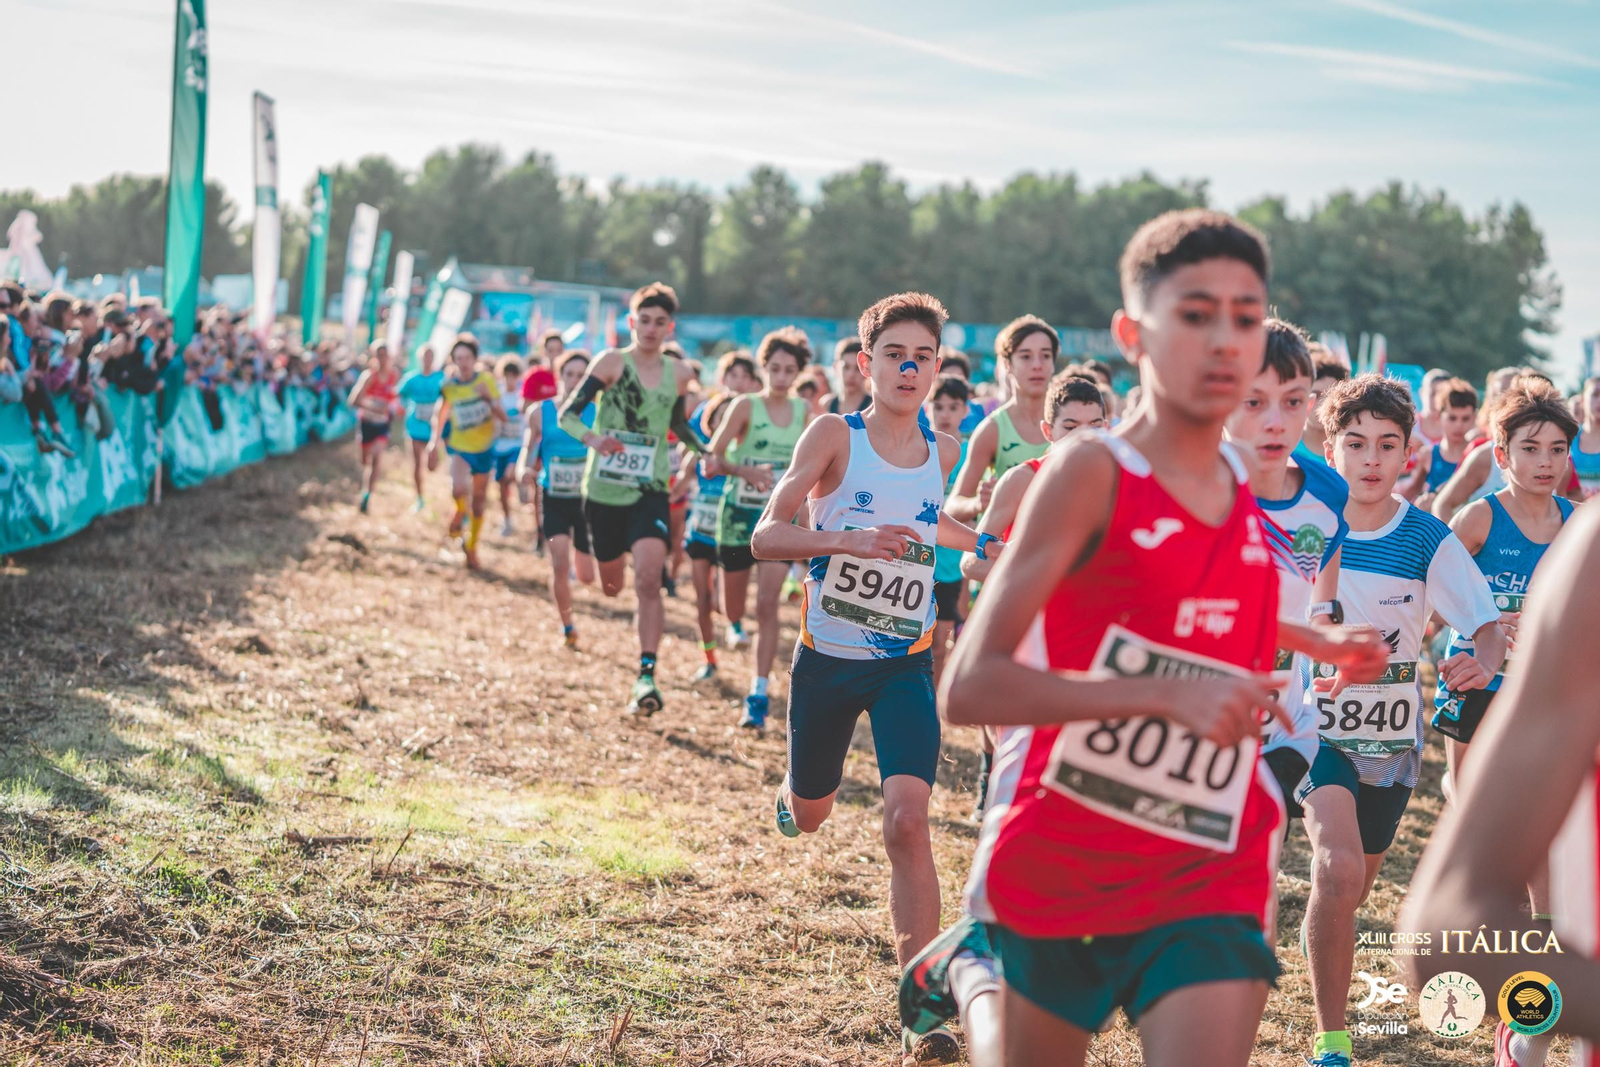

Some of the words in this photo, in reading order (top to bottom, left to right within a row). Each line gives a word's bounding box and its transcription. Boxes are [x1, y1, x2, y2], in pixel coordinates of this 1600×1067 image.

[1499, 548, 1520, 556] vive
[834, 561, 924, 611] 5940
[1316, 697, 1410, 732] 5840
[1085, 718, 1240, 792] 8010
